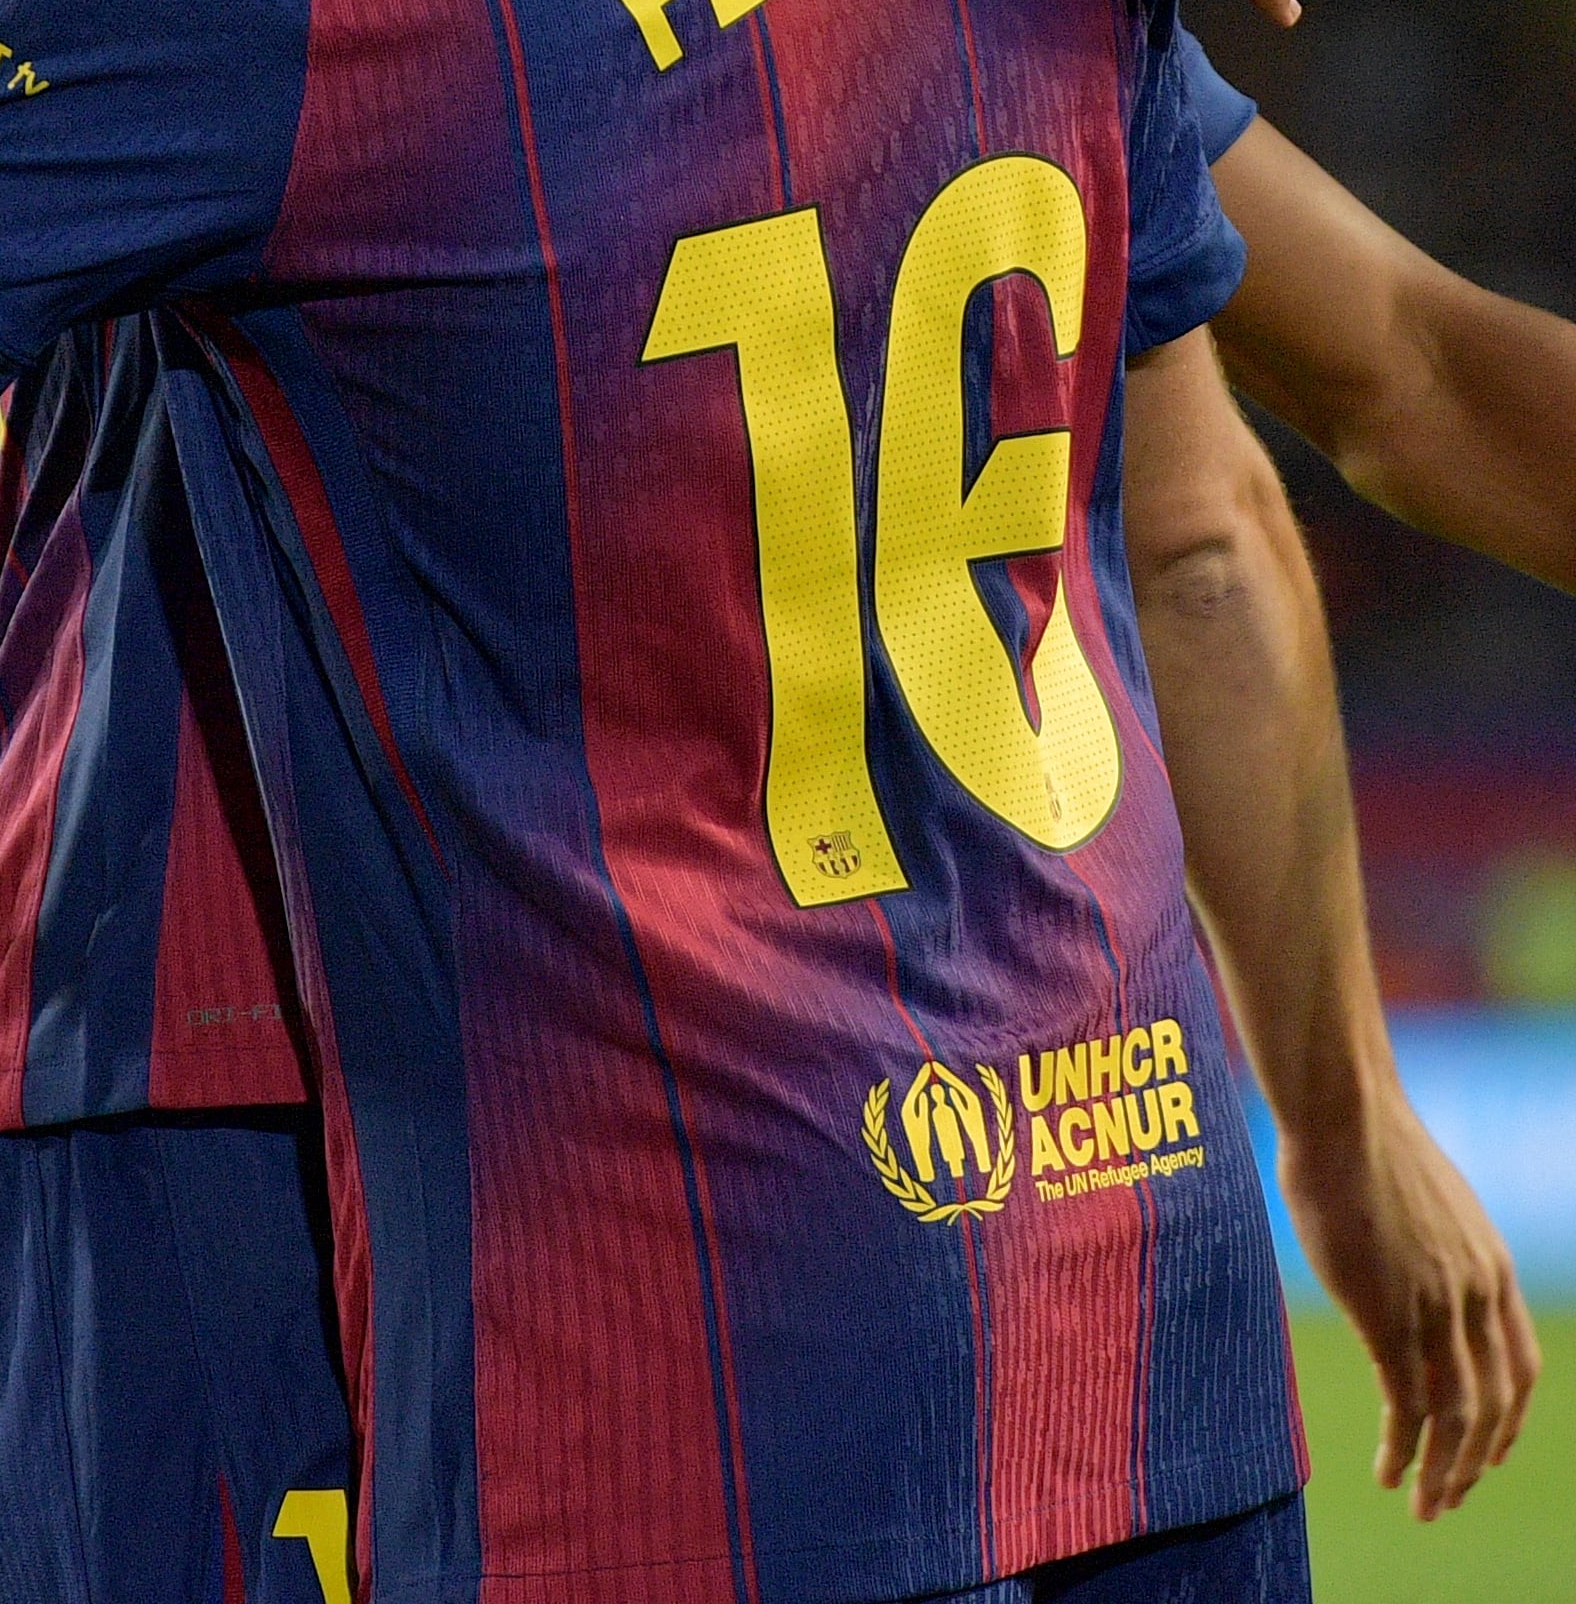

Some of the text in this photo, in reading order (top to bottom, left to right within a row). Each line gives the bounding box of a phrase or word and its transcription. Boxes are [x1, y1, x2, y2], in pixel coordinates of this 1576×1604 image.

[638, 152, 1124, 908] 16
[187, 1003, 282, 1027] DRI-FI
[1019, 1018, 1189, 1112] UNHCR
[1030, 1081, 1200, 1176] ACNUR
[1035, 1145, 1204, 1203] The UN Refugee Agency
